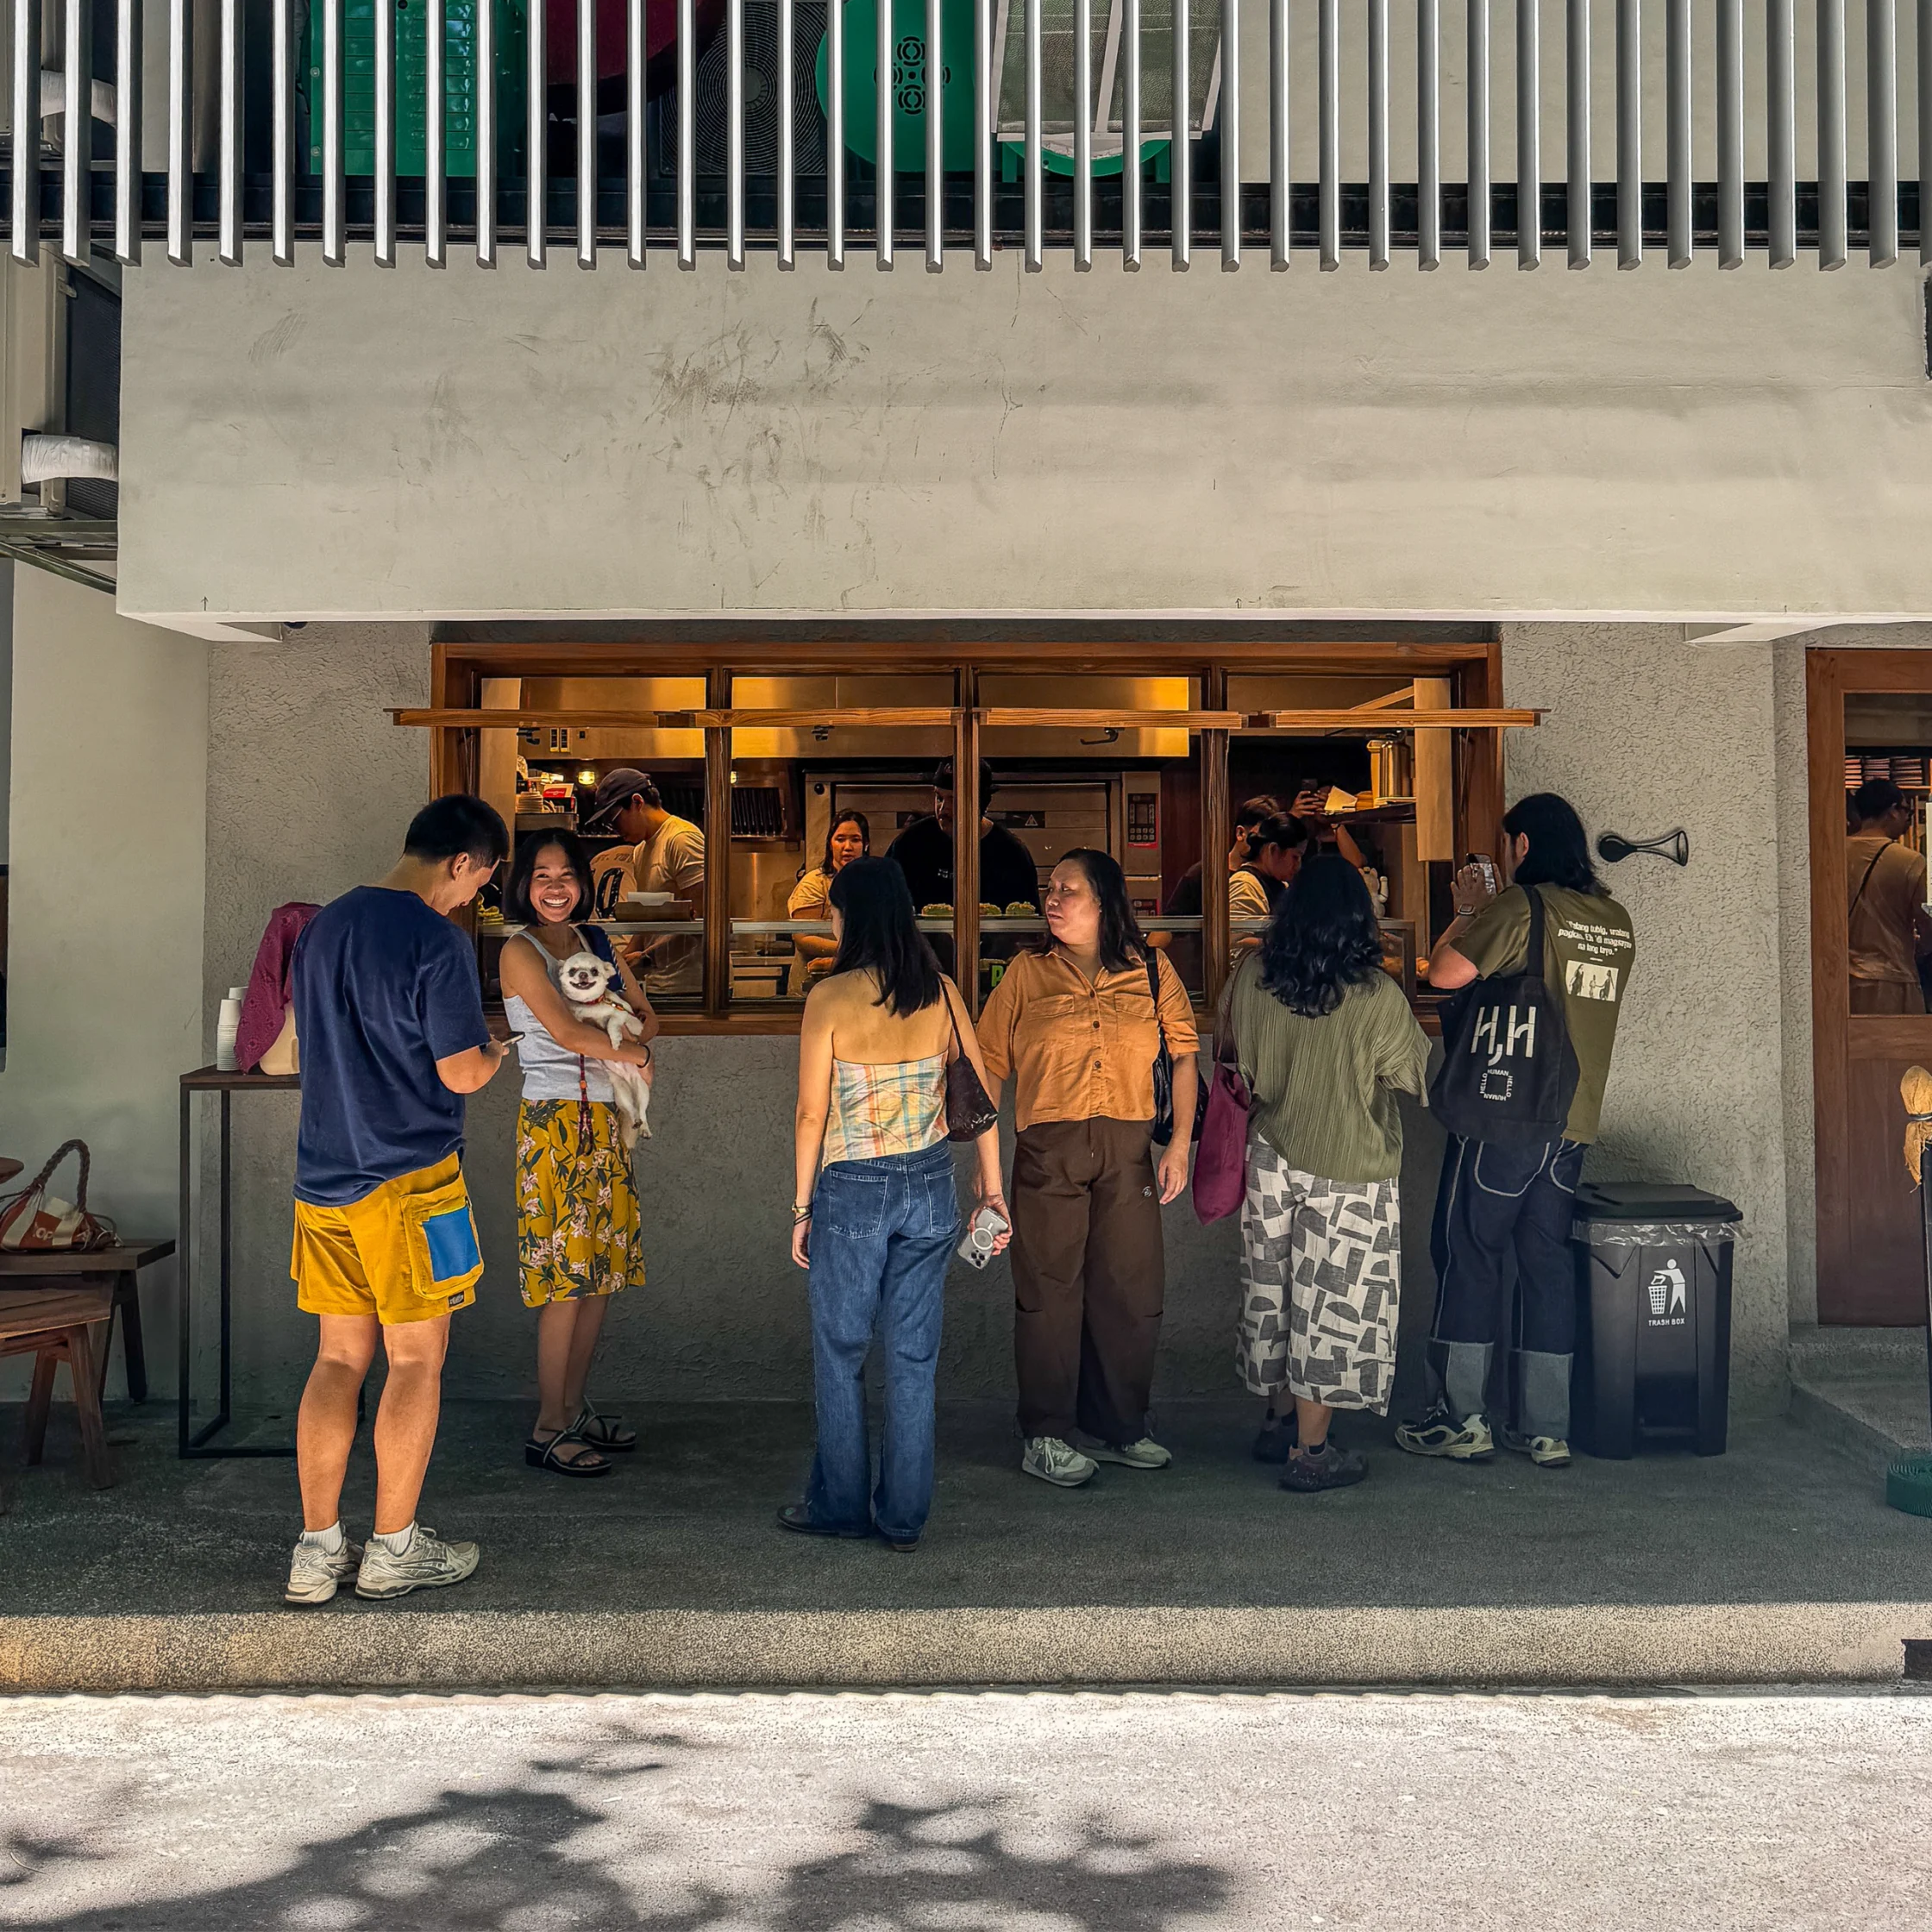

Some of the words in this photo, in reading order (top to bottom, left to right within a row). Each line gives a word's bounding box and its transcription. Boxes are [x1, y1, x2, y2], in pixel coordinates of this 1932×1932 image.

[1587, 944, 1598, 954] lang
[1479, 1072, 1488, 1095] HELLO
[1484, 1093, 1507, 1101] HUMAN
